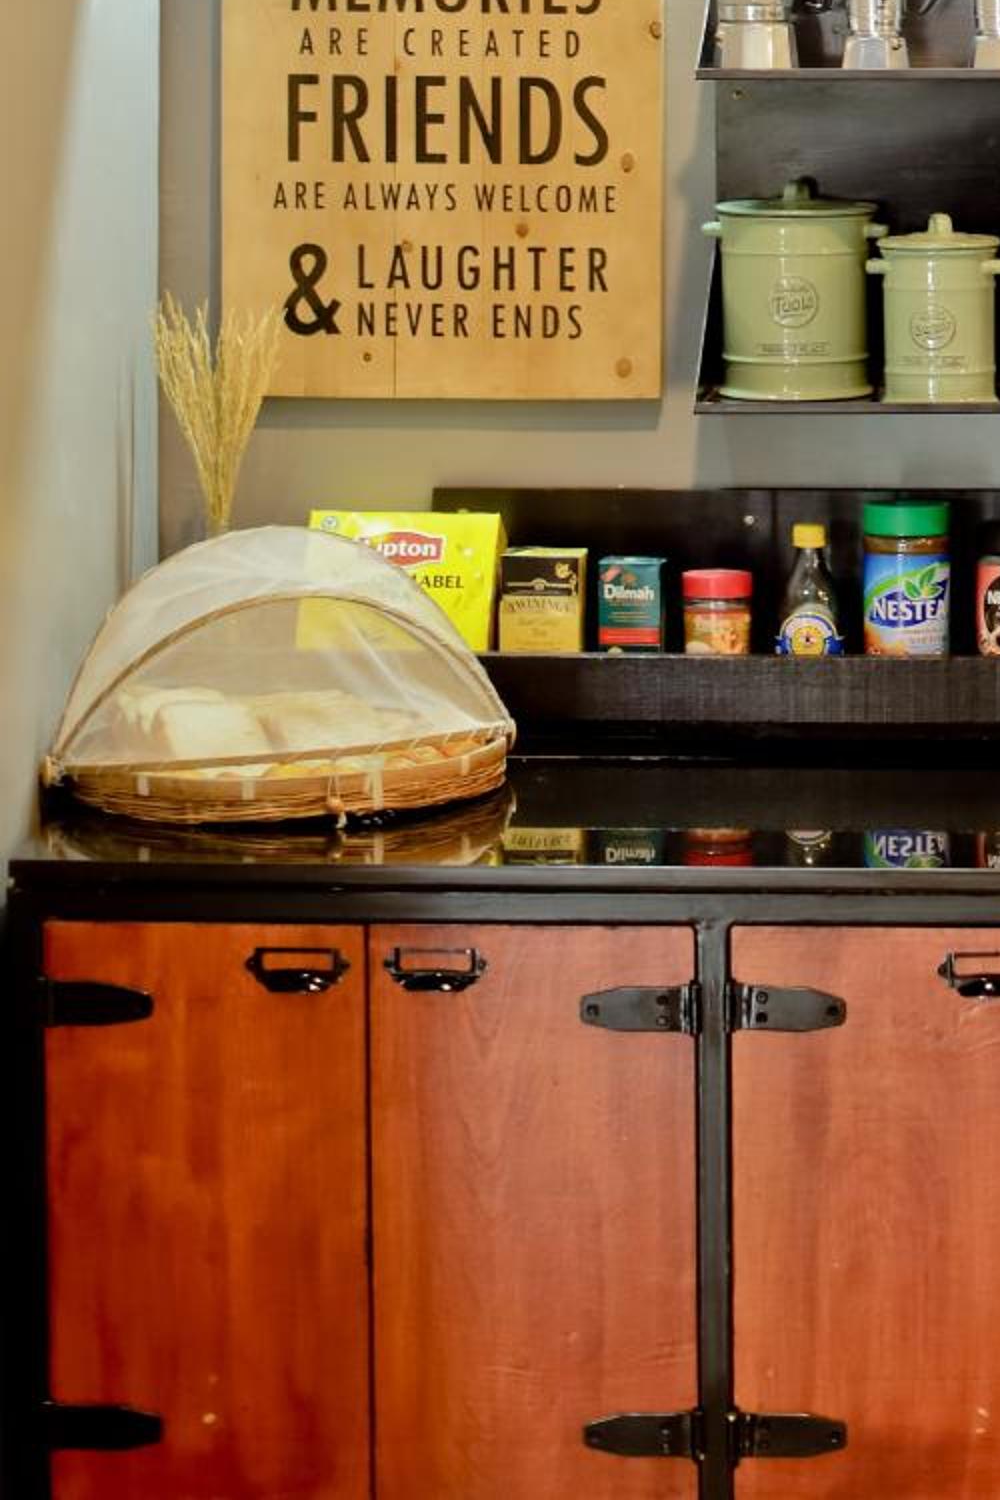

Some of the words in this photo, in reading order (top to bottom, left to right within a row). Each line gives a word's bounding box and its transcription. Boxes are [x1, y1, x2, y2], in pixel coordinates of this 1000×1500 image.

[299, 28, 370, 57] ARE
[402, 29, 582, 58] CREATED
[286, 73, 609, 167] FRIENDS
[272, 181, 325, 211] ARE
[342, 182, 457, 212] ALWAYS
[474, 183, 616, 213] WELCOME
[283, 243, 341, 337] &
[357, 243, 608, 293] LAUGHTER
[356, 303, 469, 338] NEVER
[492, 304, 583, 339] ENDS
[603, 583, 655, 600] Dilmah
